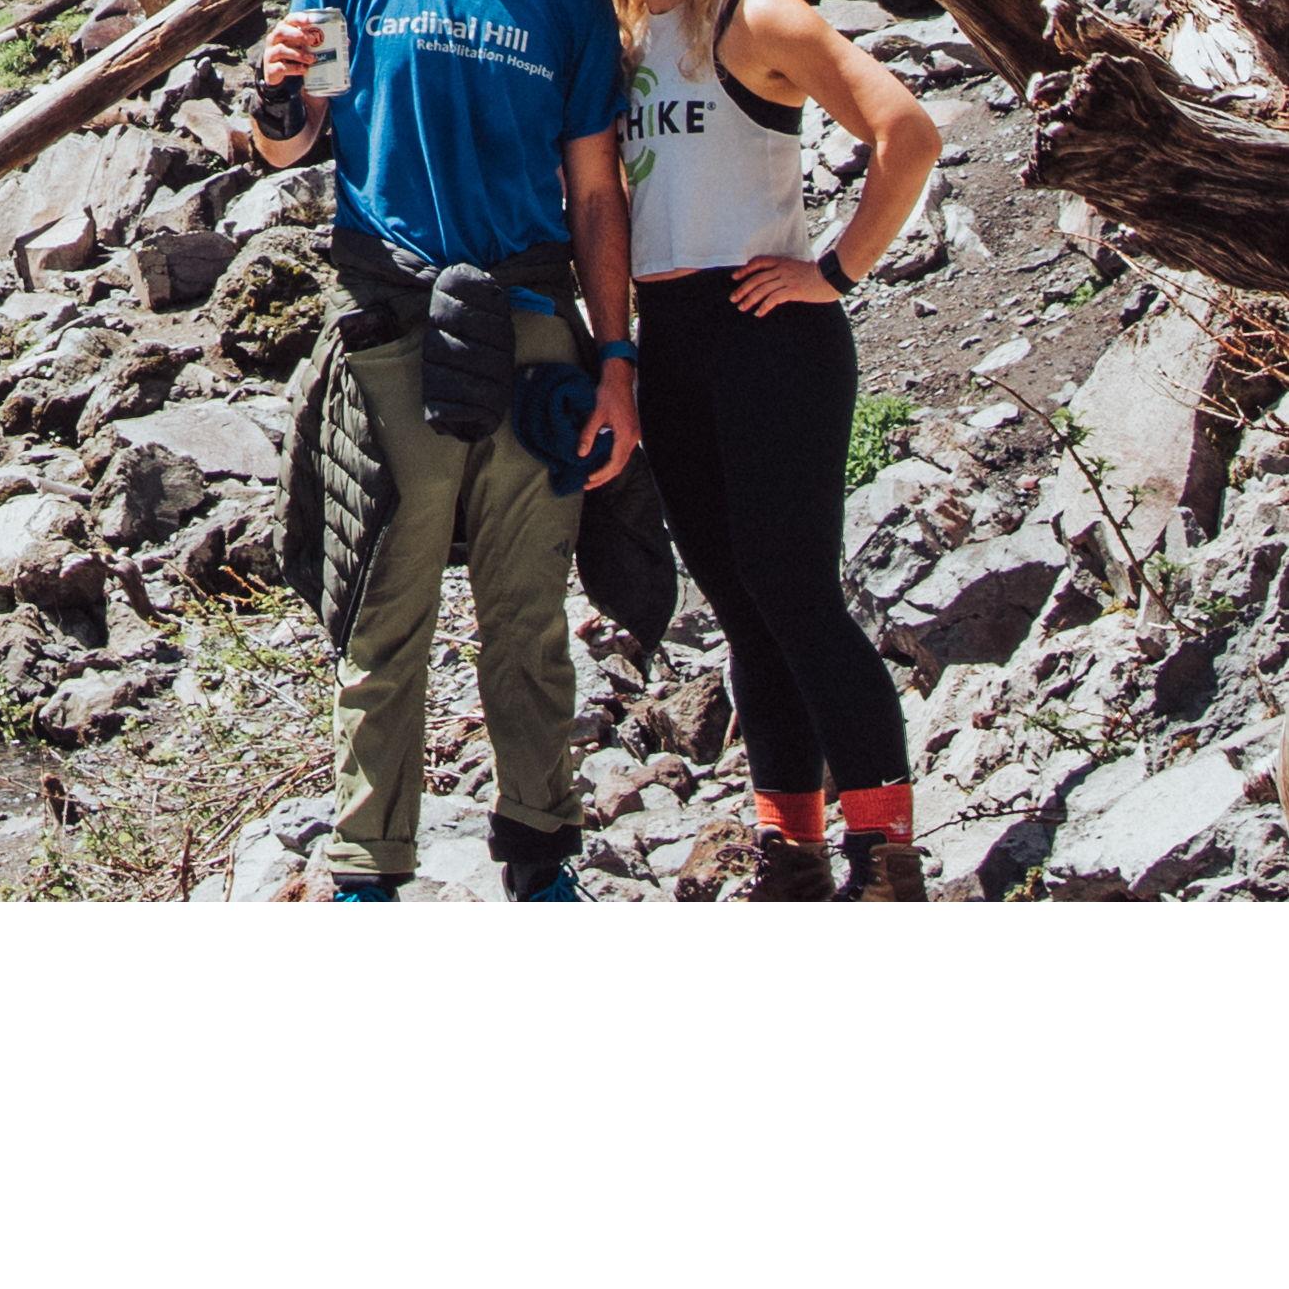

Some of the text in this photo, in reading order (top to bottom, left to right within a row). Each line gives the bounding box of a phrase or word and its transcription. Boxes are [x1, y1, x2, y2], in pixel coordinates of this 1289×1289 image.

[365, 11, 529, 53] Cardinal Hill
[417, 38, 554, 82] Rehabilitation Hospital
